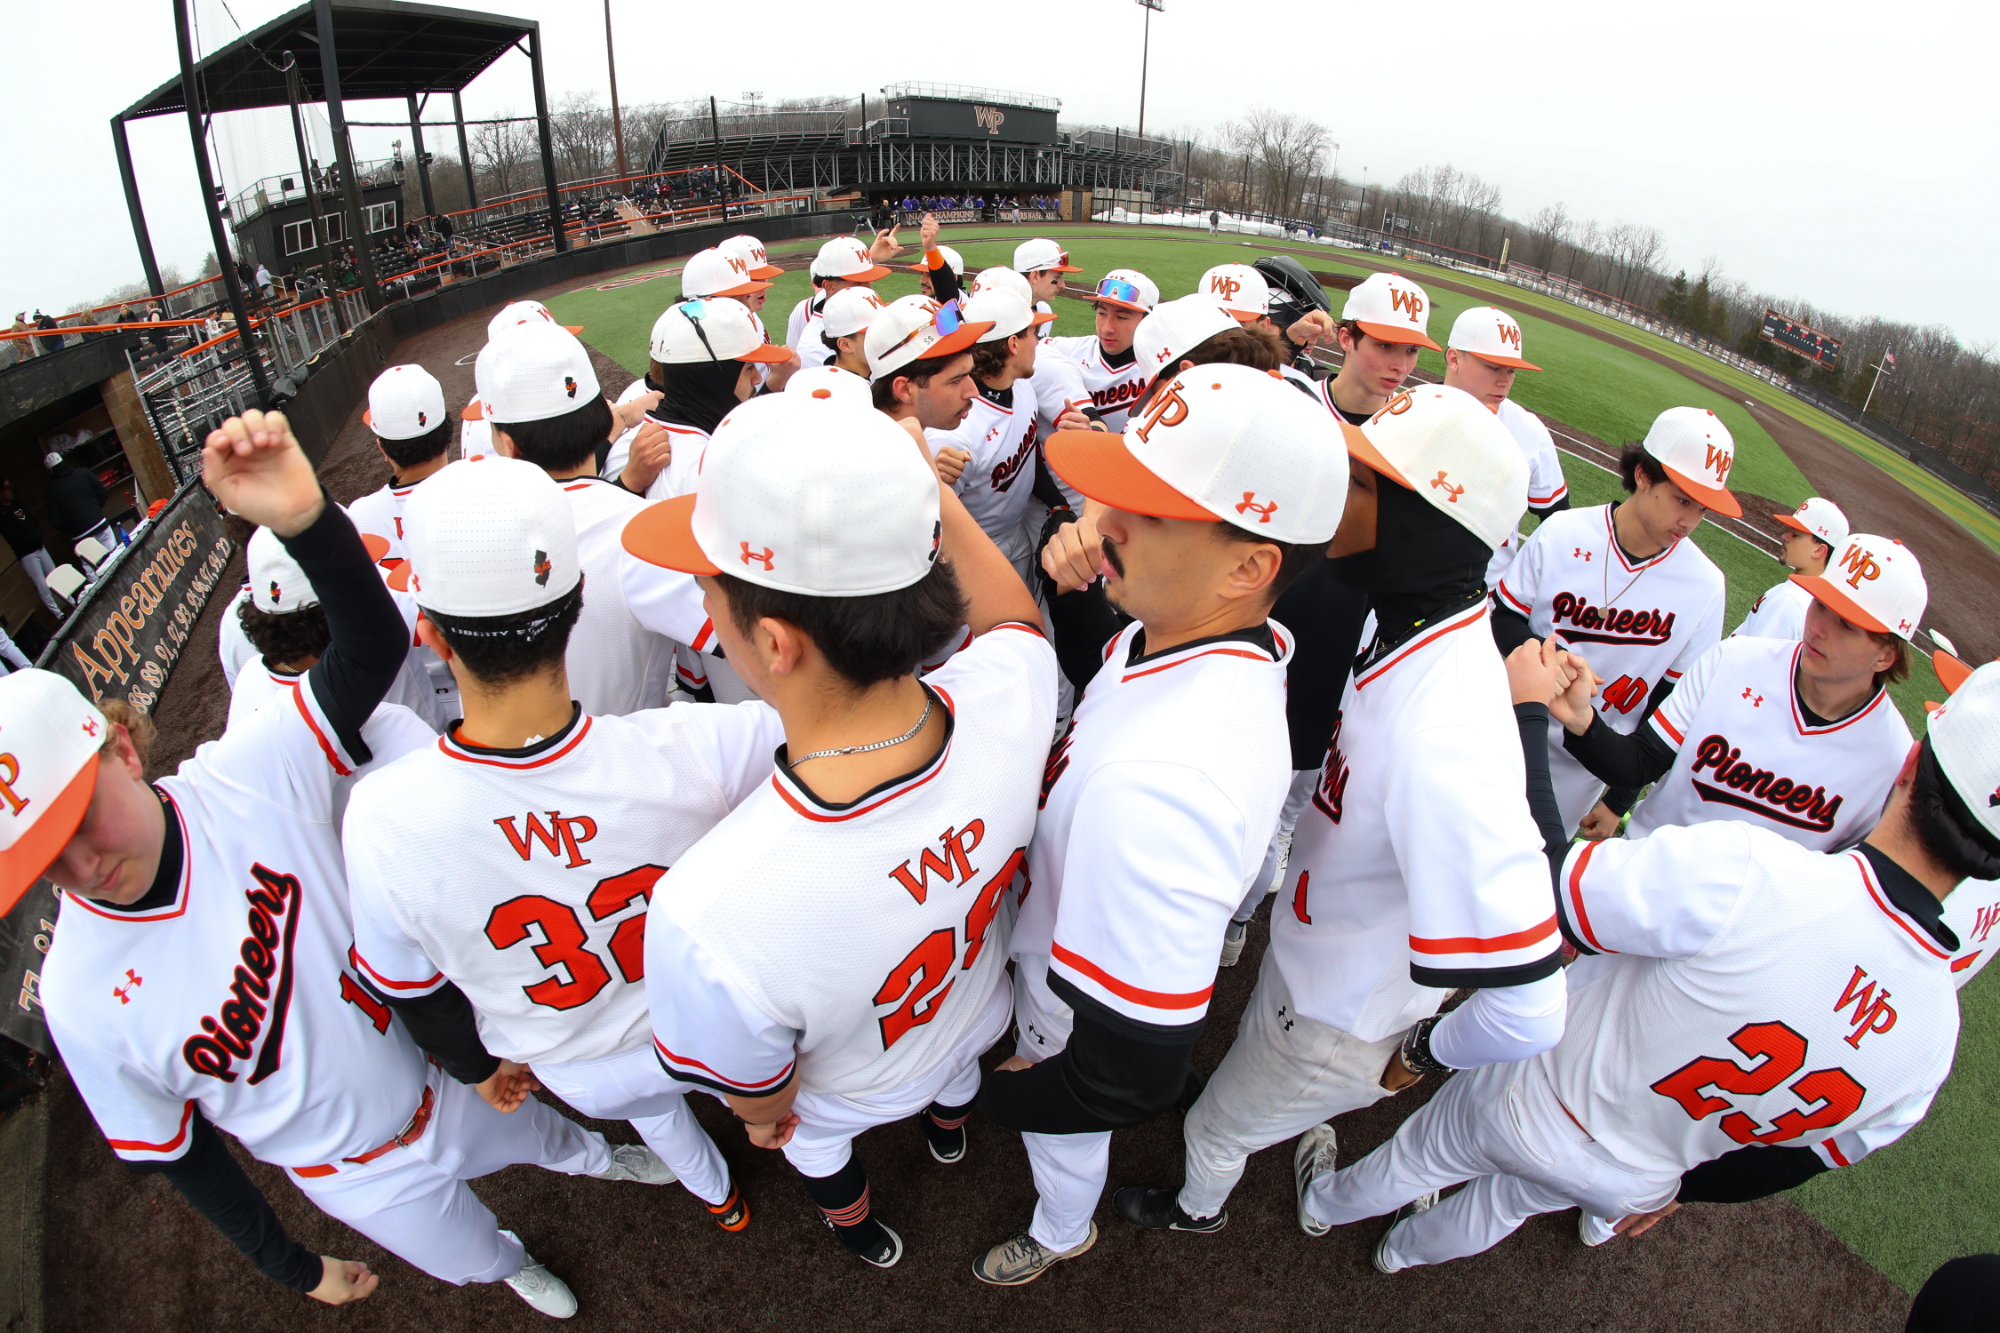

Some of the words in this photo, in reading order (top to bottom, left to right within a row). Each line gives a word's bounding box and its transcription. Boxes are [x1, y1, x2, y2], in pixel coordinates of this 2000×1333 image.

[974, 105, 1004, 134] WP
[1000, 212, 1027, 220] PIONERS
[1028, 212, 1055, 220] BASEALL
[1211, 275, 1241, 301] WP
[1390, 288, 1424, 323] WP
[1498, 323, 1520, 351] WP
[1089, 377, 1147, 410] neers
[1704, 443, 1732, 483] WP
[1838, 543, 1881, 590] WP
[72, 520, 198, 703] Appearances
[155, 638, 179, 668] 91,
[215, 537, 231, 558] 22
[1552, 591, 1676, 646] Pioneers
[1601, 674, 1649, 715] 40
[0, 752, 31, 817] P
[1691, 734, 1844, 833] Pioneers
[494, 811, 598, 868] WP
[888, 818, 985, 905] WP
[484, 863, 670, 1011] 32
[183, 862, 302, 1085] Pioneers
[1833, 965, 1898, 1050] WP
[1650, 1020, 1867, 1146] 23
